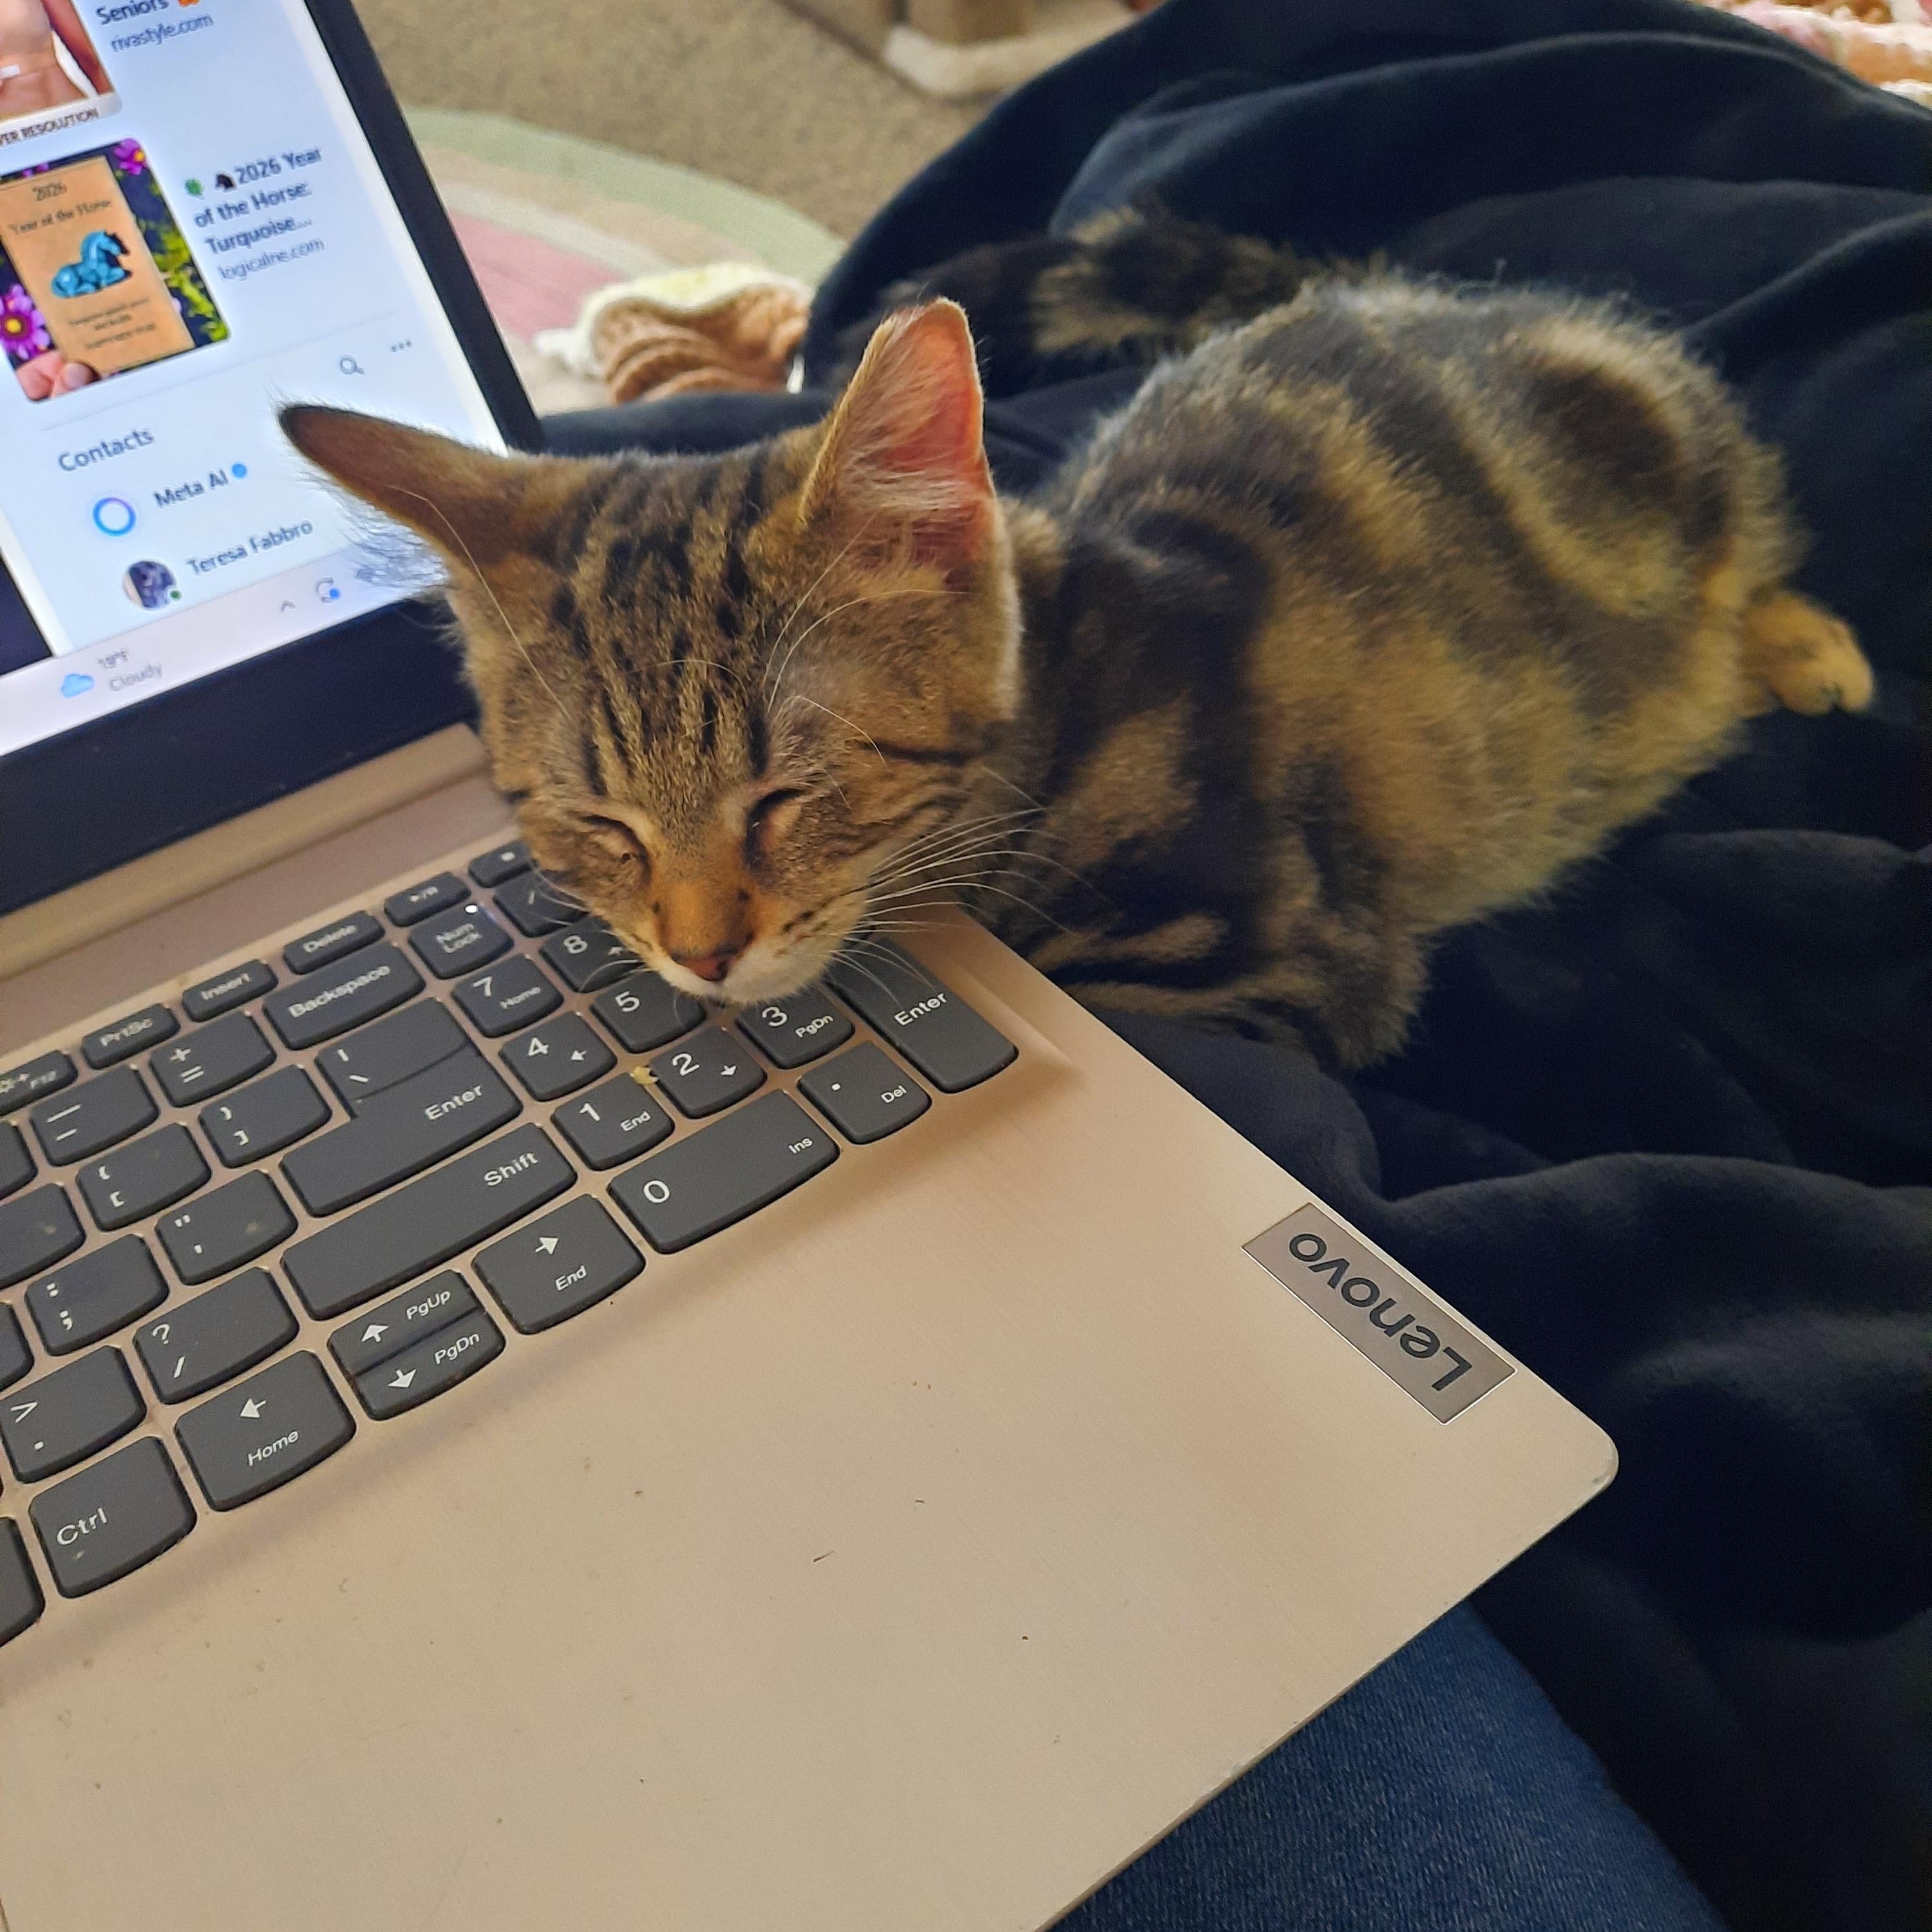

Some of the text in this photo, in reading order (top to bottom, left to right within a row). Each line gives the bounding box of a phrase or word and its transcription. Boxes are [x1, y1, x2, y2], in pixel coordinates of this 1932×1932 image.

[96, 0, 169, 24] Seniors
[234, 149, 321, 185] 2026 Year
[194, 208, 214, 227] of
[216, 202, 249, 221] the
[59, 428, 155, 471] Contacts
[153, 469, 229, 507] Meta AI
[186, 520, 313, 575] Teresa Fabbro
[109, 663, 162, 692] Cloudy
[303, 924, 357, 953] Delete
[435, 923, 475, 945] Num
[442, 932, 482, 954] Lock
[563, 935, 588, 954] 8
[200, 972, 251, 1000] Insert
[288, 965, 390, 1018] Backspace
[473, 976, 492, 997] 7
[500, 987, 541, 1009] Home
[615, 991, 640, 1012] 5
[894, 993, 947, 1025] Enter
[762, 1007, 788, 1027] 3
[795, 1016, 833, 1038] PgDn
[99, 1018, 153, 1047] PrtSc
[527, 1037, 549, 1056] 4
[672, 1053, 700, 1076] 2
[30, 1070, 57, 1090] F12
[424, 1085, 482, 1120] Enter
[881, 1085, 907, 1103] Del
[580, 1103, 601, 1121] 1
[620, 1111, 651, 1132] End
[788, 1138, 813, 1153] Ins
[484, 1153, 538, 1186] Shift
[643, 1180, 670, 1203] 0
[555, 1265, 587, 1291] End
[406, 1289, 451, 1320] PgUp
[1289, 1233, 1473, 1392] Lenovo
[152, 1323, 170, 1345] ?
[435, 1334, 480, 1365] PgDn
[10, 1401, 38, 1423] >
[248, 1431, 299, 1466] Home
[57, 1508, 107, 1545] Ctrl
